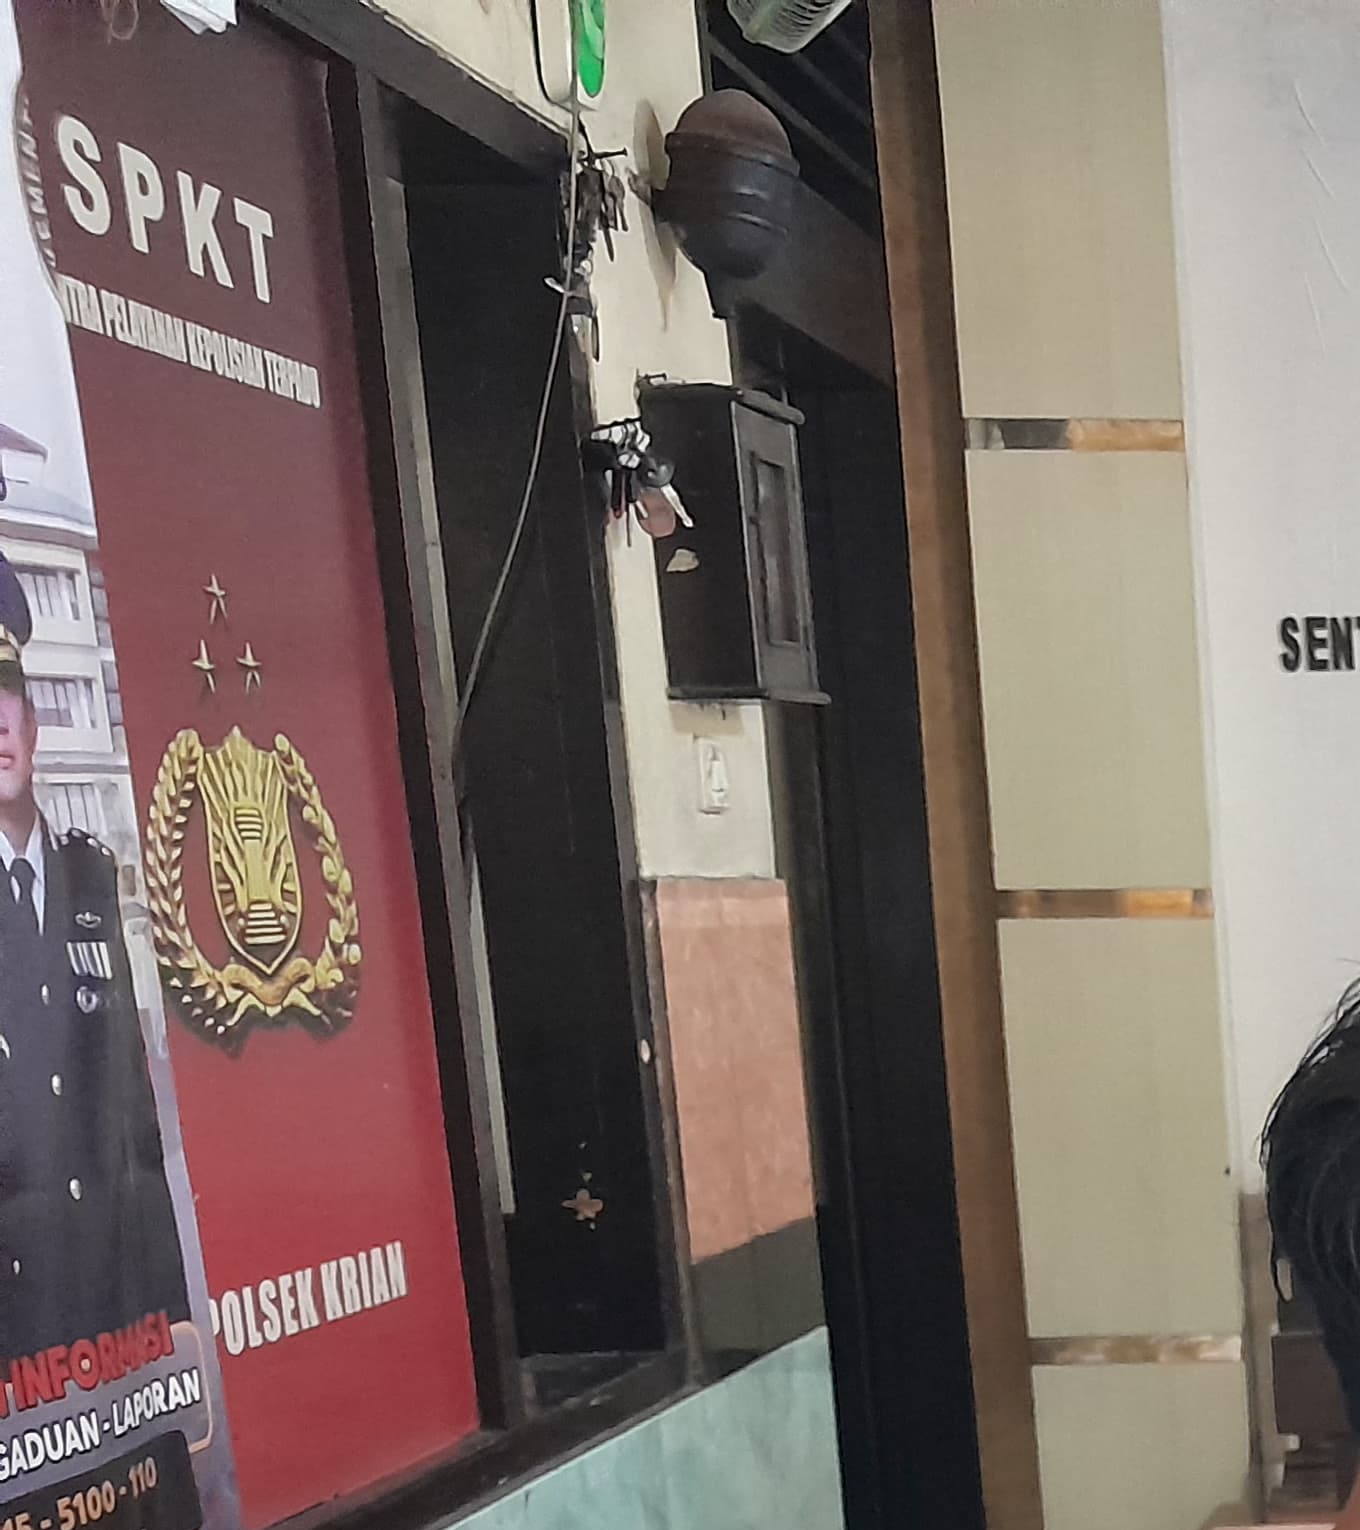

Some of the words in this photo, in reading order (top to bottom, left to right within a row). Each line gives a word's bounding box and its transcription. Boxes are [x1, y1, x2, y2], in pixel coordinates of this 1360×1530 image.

[56, 115, 273, 304] SPKT
[320, 1240, 407, 1321] KRIAN
[11, 1311, 173, 1410] INFORMASI
[129, 1456, 158, 1500] 110
